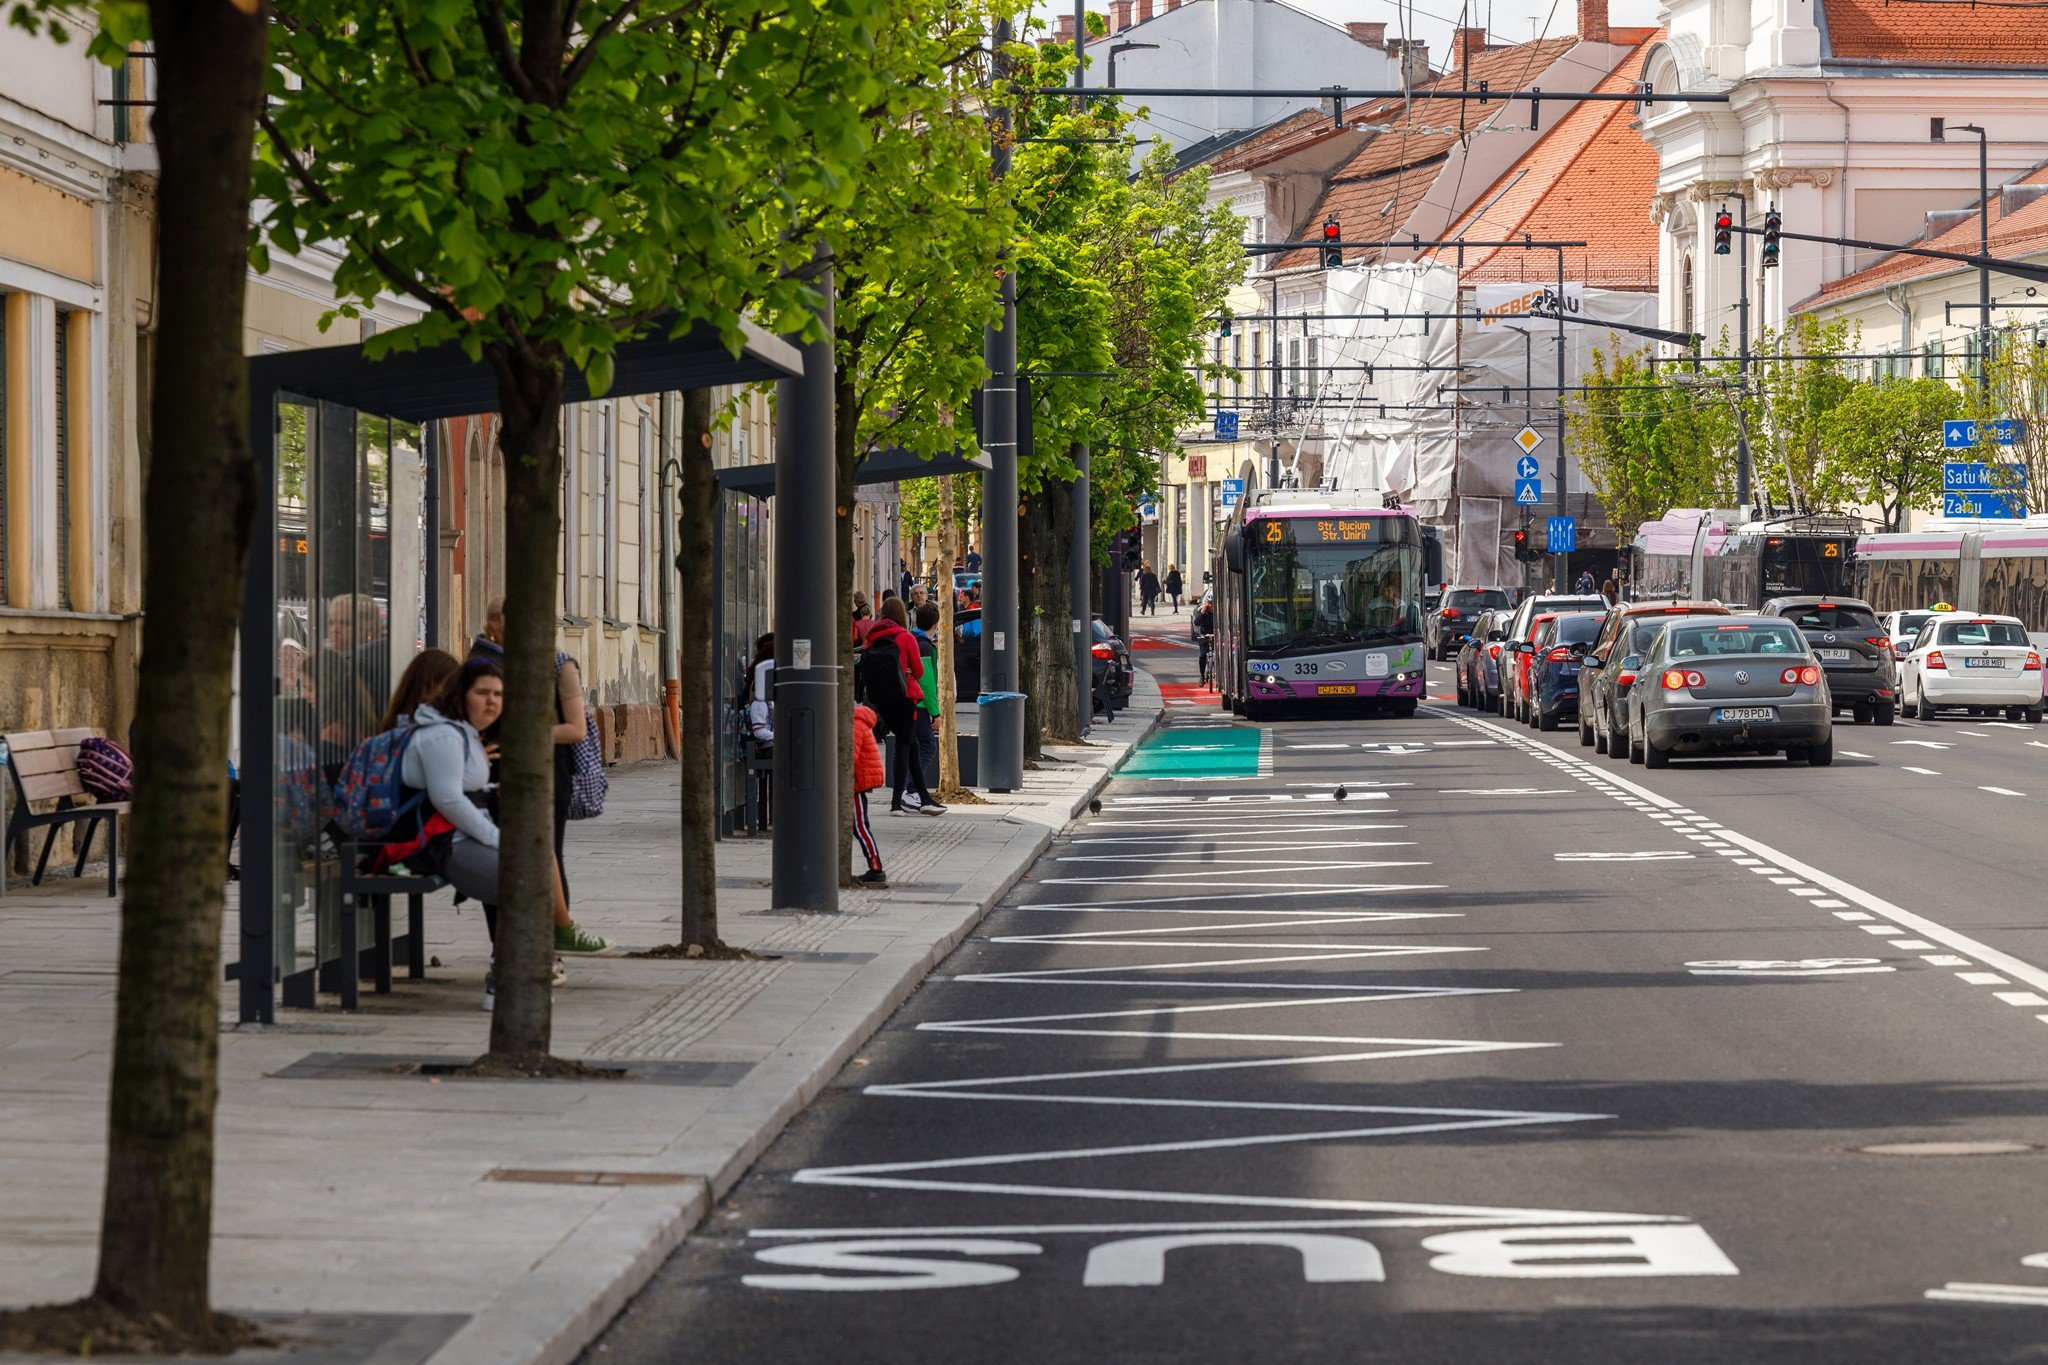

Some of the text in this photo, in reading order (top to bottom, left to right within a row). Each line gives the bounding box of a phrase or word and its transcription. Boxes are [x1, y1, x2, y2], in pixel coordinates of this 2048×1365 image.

[1947, 469, 1976, 484] Satu
[1266, 522, 1281, 541] 25
[1317, 520, 1371, 531] Str. Bucium
[1322, 530, 1367, 540] Str. Unirii
[1825, 543, 1838, 556] 25
[1971, 658, 1980, 666] CJ
[1981, 658, 1990, 666] 68
[1294, 663, 1318, 675] 339
[1723, 709, 1771, 719] CJ 78 PDA
[742, 1222, 1739, 1291] BUS
